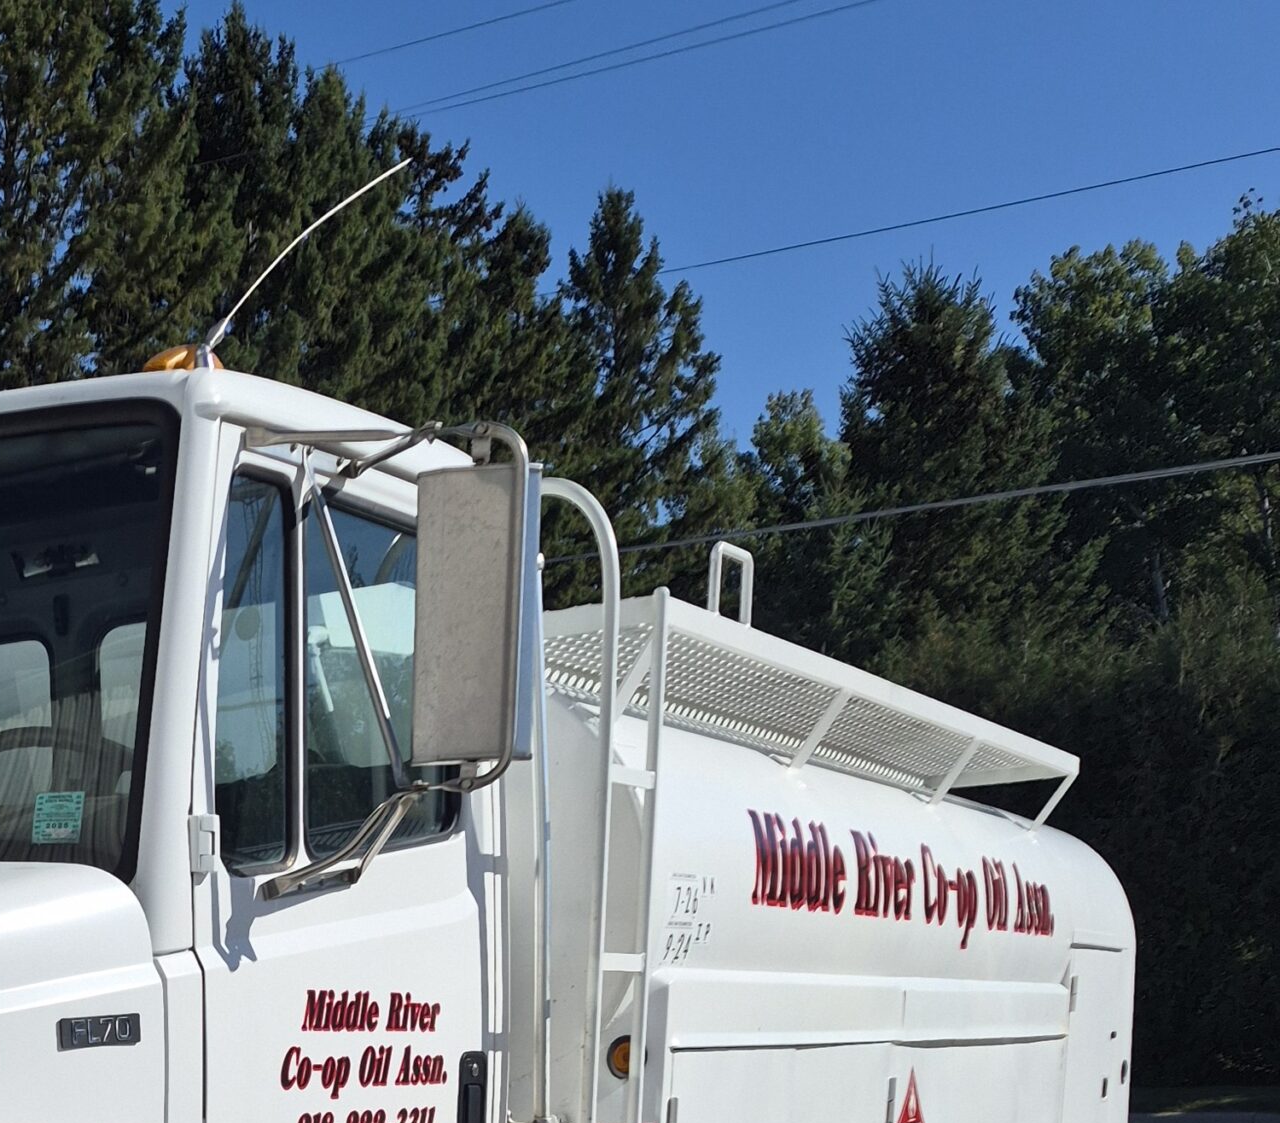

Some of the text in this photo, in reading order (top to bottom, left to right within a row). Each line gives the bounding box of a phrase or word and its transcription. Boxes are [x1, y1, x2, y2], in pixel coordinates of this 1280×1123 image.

[747, 808, 1055, 950] Middle River Co-op Oil Assn.
[71, 1016, 131, 1045] FL70
[301, 989, 441, 1032] Middle River
[280, 1045, 448, 1099] Co-op Oil Assn.
